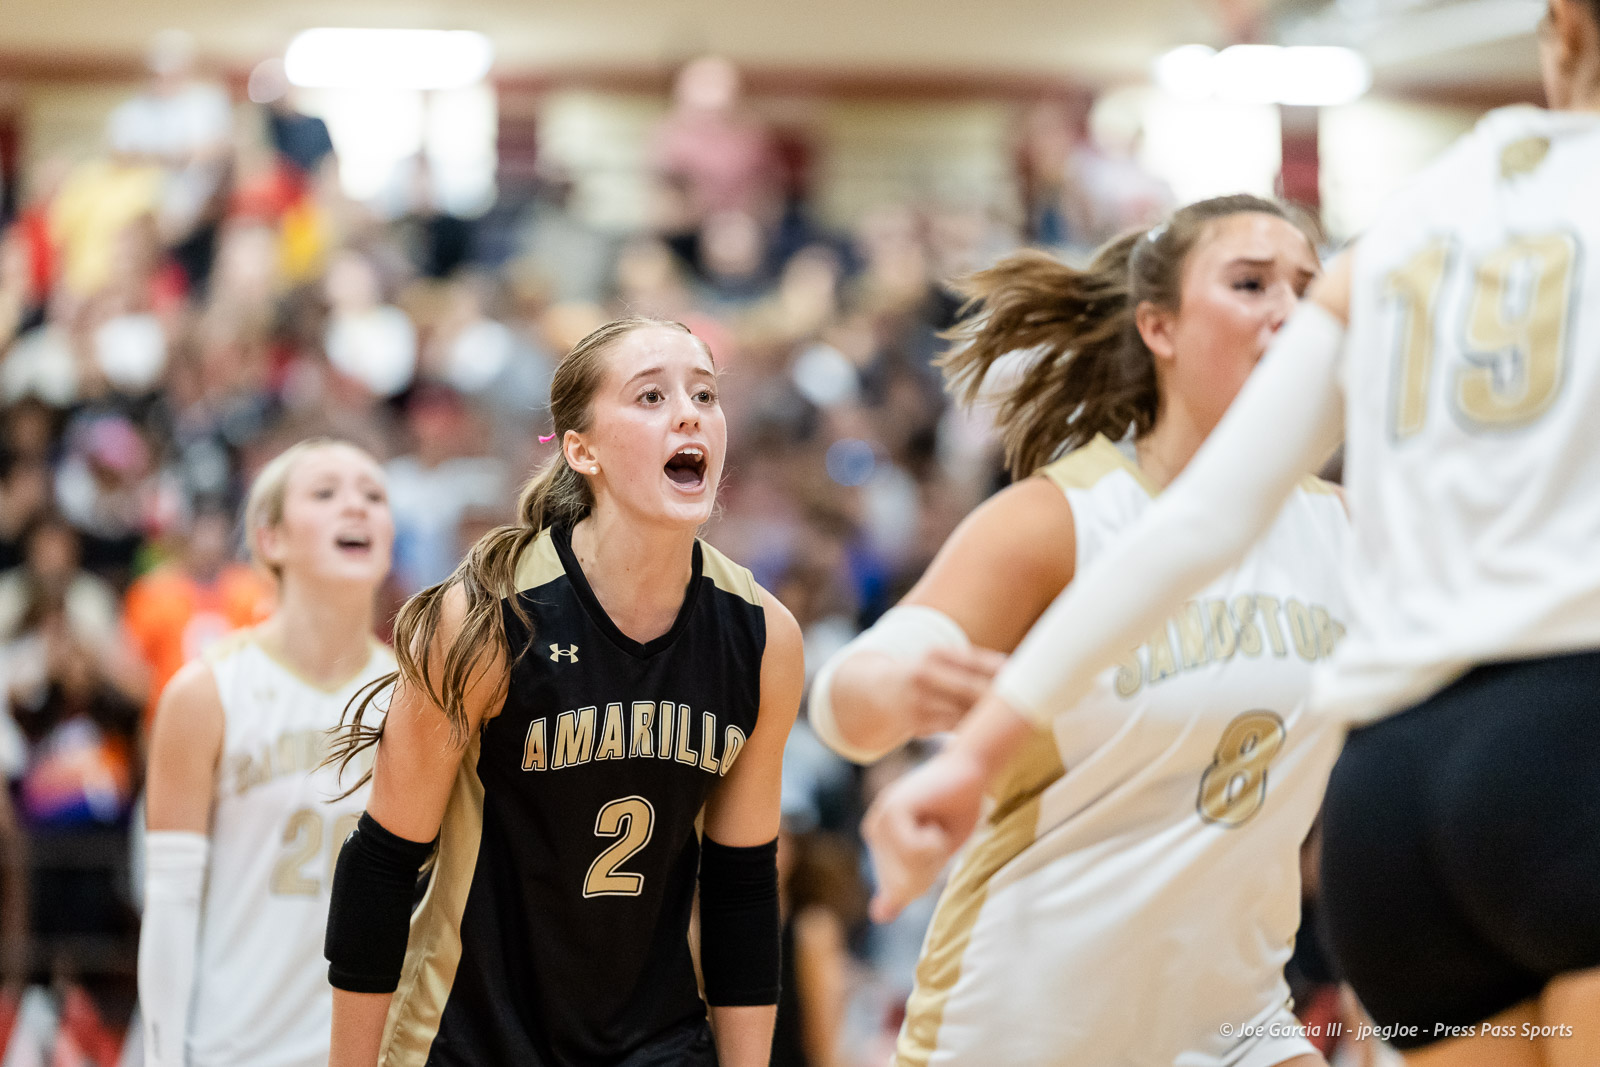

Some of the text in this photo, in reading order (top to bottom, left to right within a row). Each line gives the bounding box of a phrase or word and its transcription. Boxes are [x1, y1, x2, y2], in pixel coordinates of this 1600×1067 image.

[1376, 230, 1583, 444] 19
[1114, 595, 1346, 698] SANDSTOR
[521, 700, 747, 776] AMARILLO
[1197, 709, 1286, 828] 8
[583, 795, 655, 898] 2
